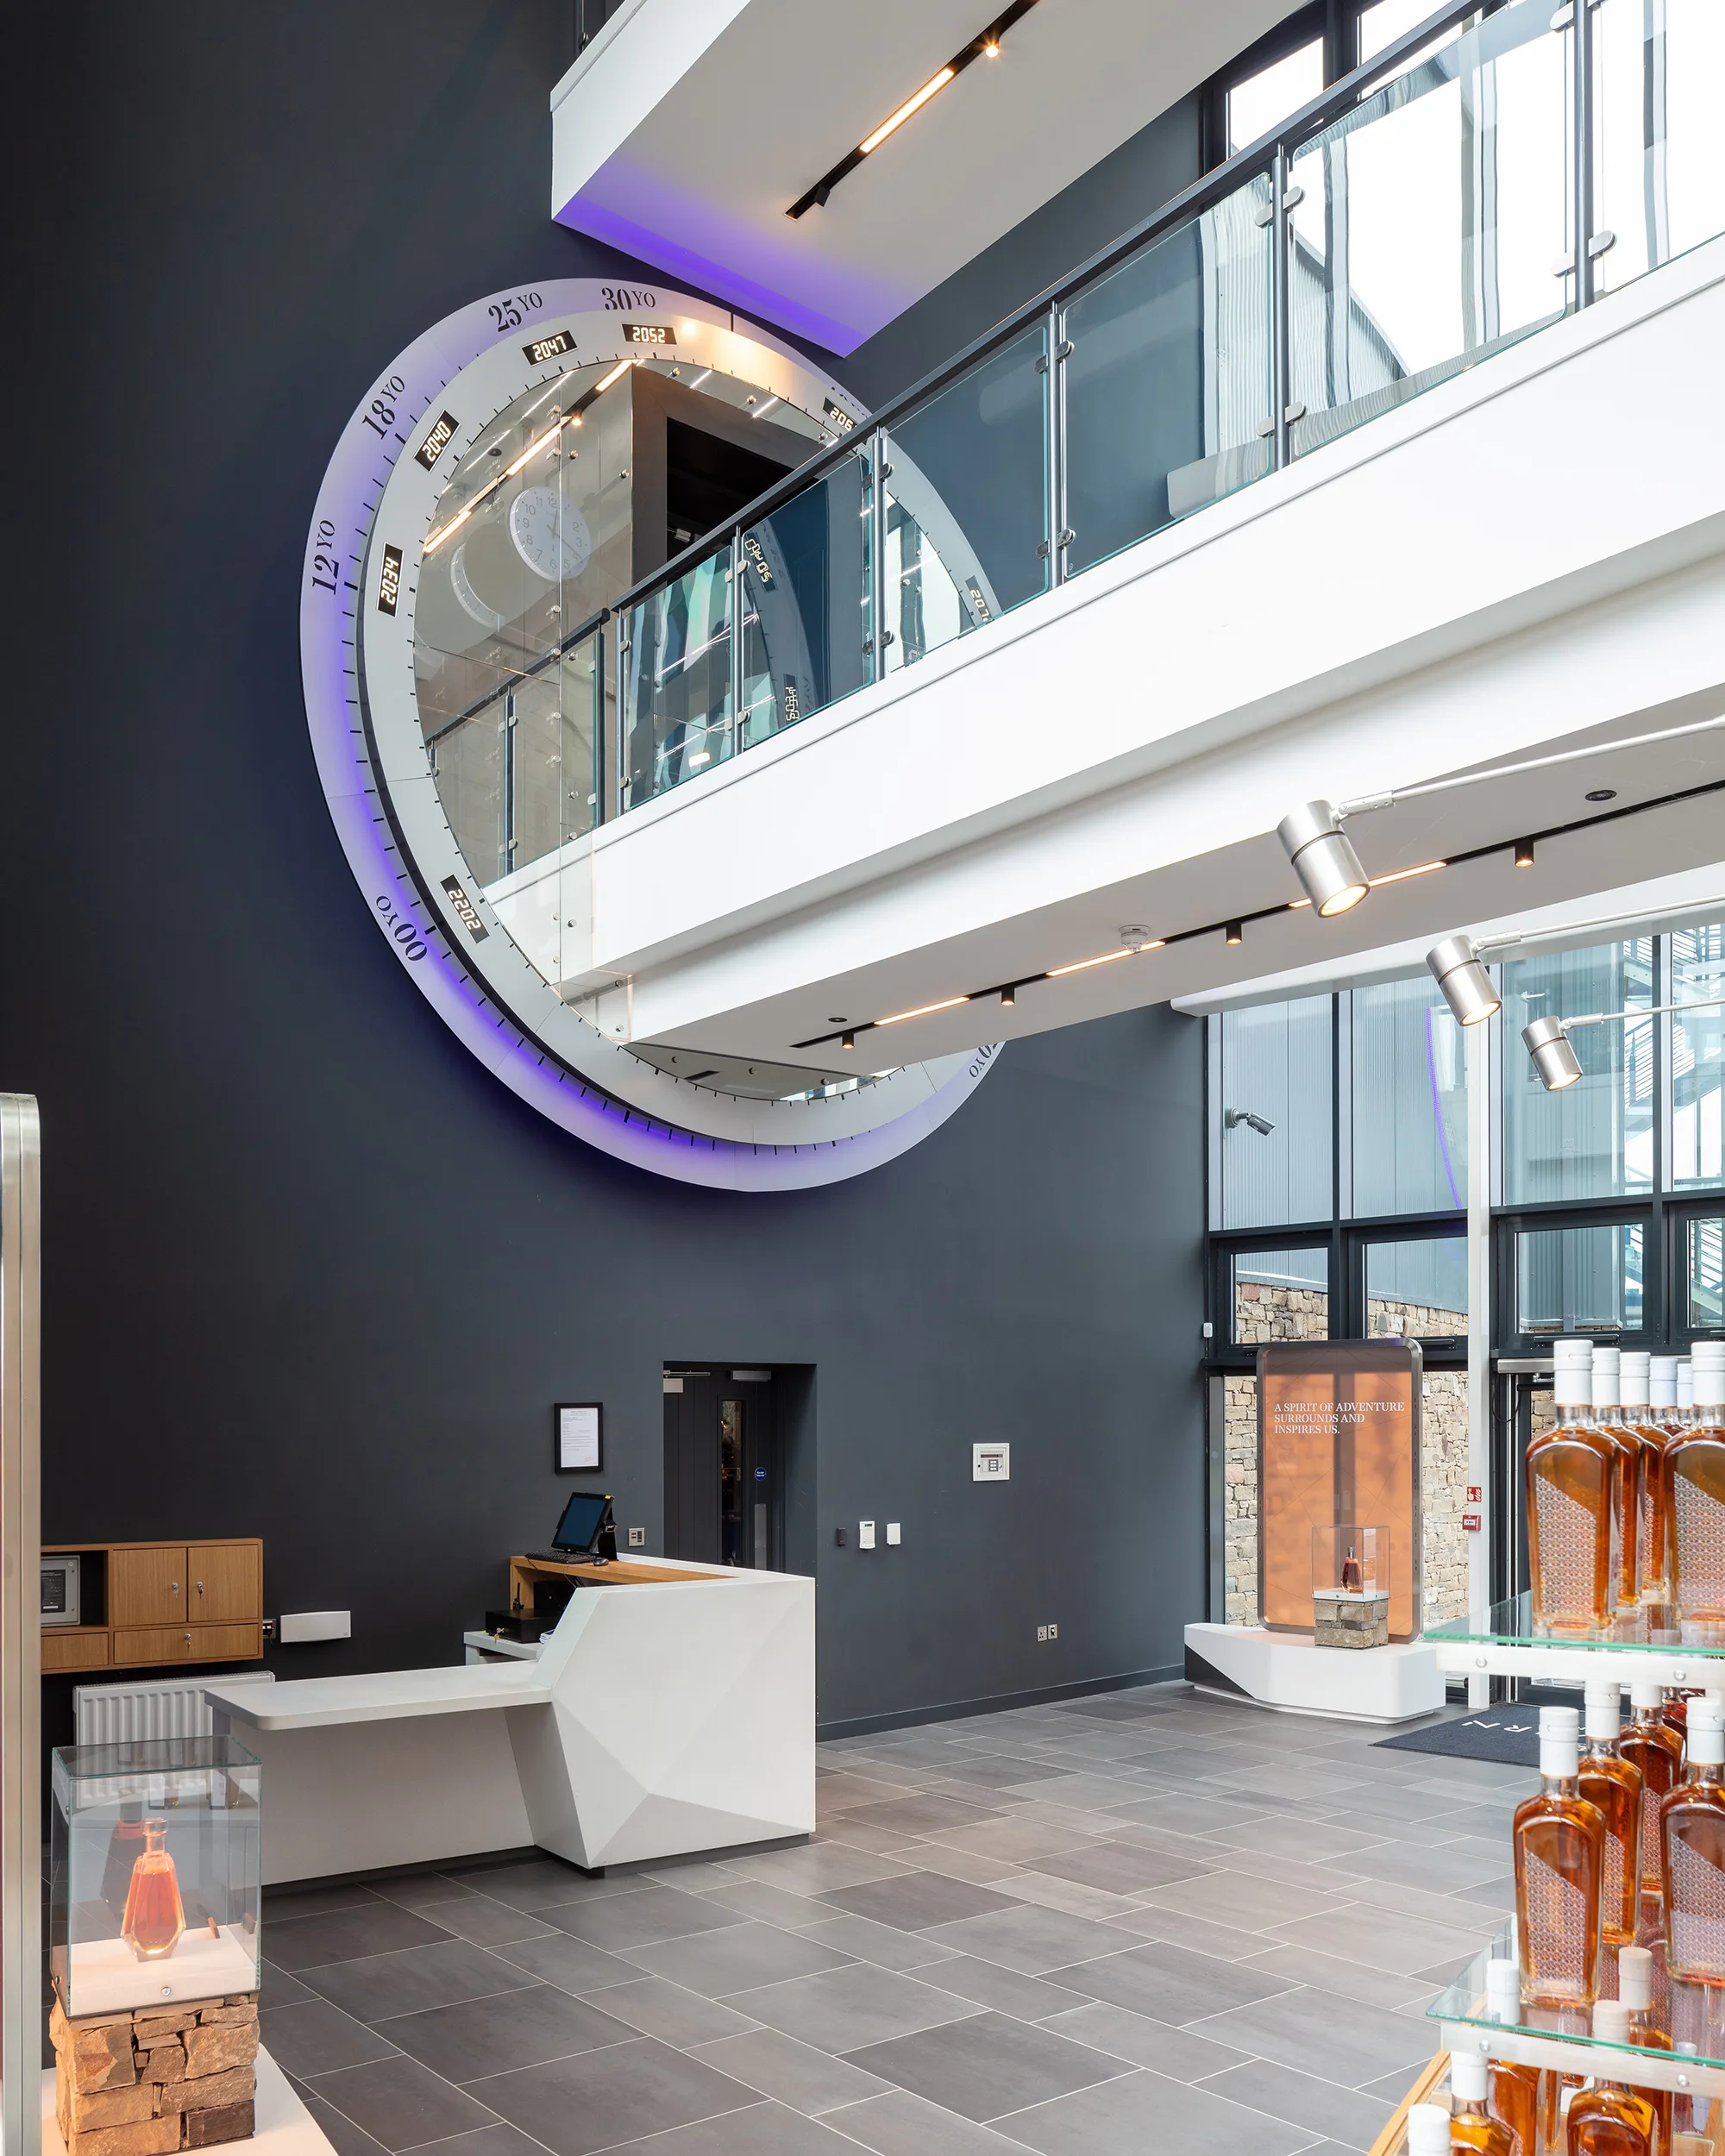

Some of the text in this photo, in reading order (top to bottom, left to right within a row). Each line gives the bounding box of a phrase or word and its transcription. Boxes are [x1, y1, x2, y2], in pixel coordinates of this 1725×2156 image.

[632, 326, 666, 344] 2052
[532, 335, 567, 361] 2047
[830, 406, 857, 432] 206
[422, 420, 451, 462] 2040
[380, 556, 399, 605] 2034
[1274, 1402, 1404, 1412] A SPIRIT OF ADVENTURE
[1274, 1413, 1364, 1423] SURROUNDS AND
[1275, 1425, 1340, 1434] INSPIRES US.
